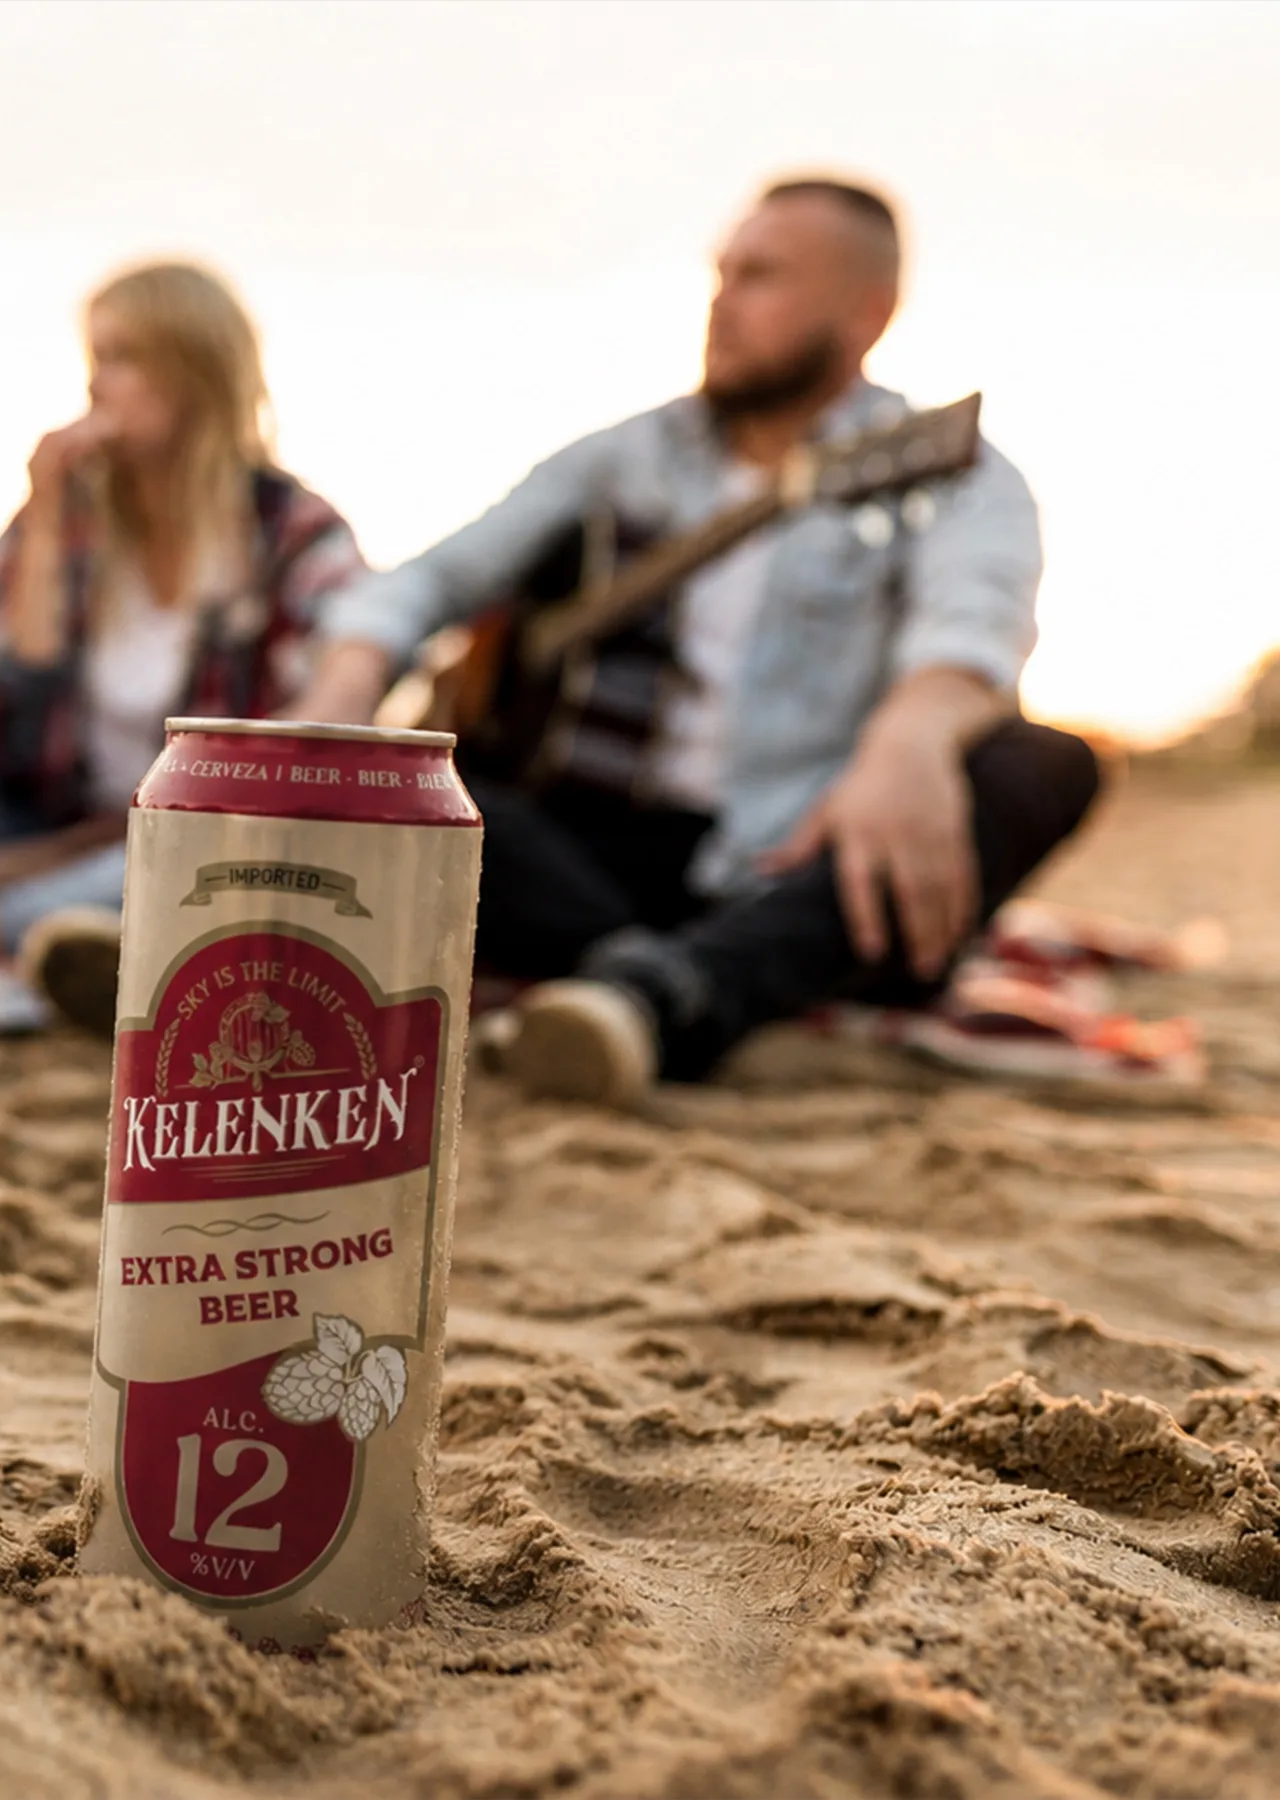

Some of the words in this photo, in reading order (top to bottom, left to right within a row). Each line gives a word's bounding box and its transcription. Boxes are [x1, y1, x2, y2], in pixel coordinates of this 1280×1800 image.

[190, 759, 268, 782] CERVEZA
[289, 765, 341, 785] BEER
[358, 769, 403, 789] BIER
[228, 867, 320, 892] IMPORTED
[177, 978, 213, 1021] SKY
[213, 965, 236, 990] IS
[239, 960, 284, 983] THE
[288, 966, 348, 1015] LIMIT
[122, 1067, 418, 1172] KELENKEN
[120, 1252, 227, 1287] EXTRA
[235, 1227, 394, 1280] STRONG
[198, 1289, 300, 1326] BEER
[202, 1406, 265, 1434] ALC.
[169, 1433, 288, 1553] 12
